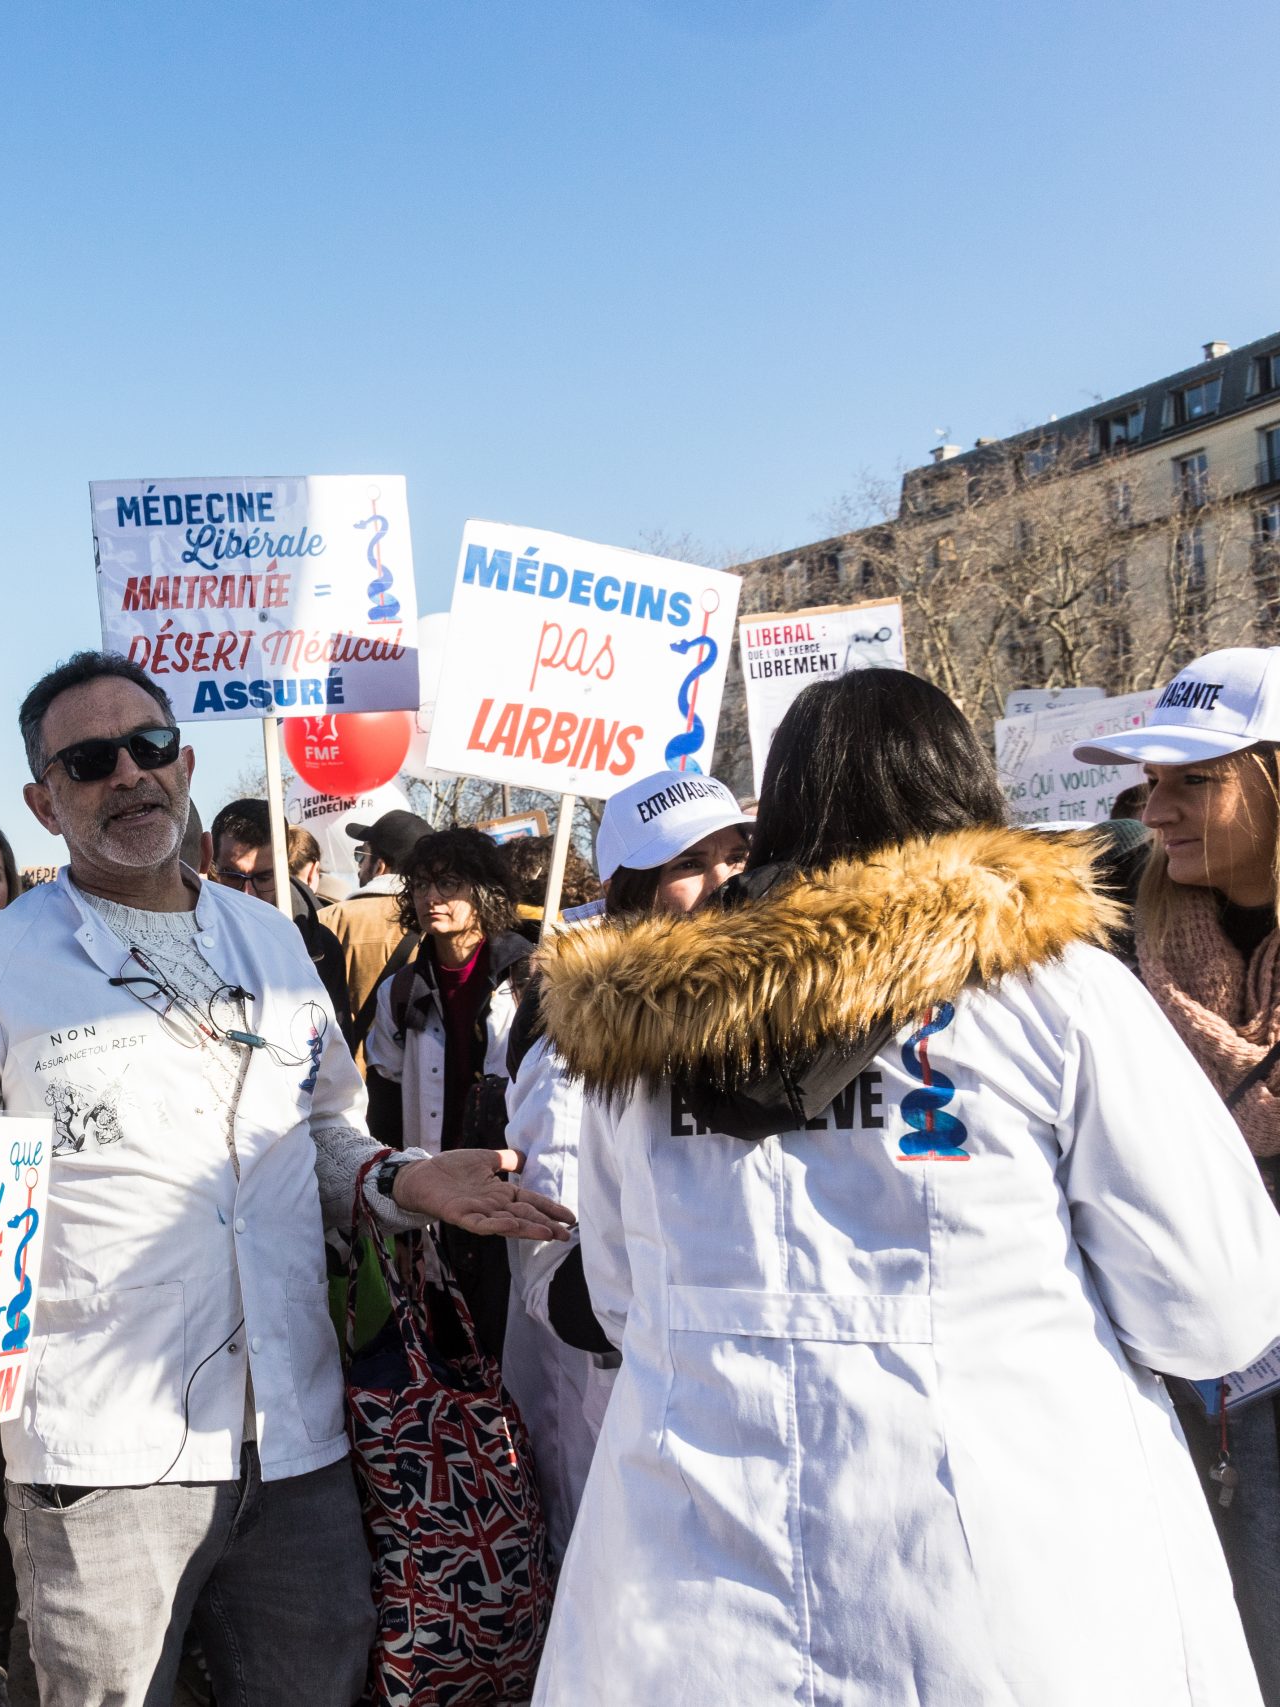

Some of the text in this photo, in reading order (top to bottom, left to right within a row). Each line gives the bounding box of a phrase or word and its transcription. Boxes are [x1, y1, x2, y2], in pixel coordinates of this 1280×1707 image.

[117, 485, 275, 527] MÉDECINE
[182, 524, 327, 570] Libérale
[121, 558, 291, 612] MALTRAITÉE
[462, 543, 692, 627] MÉDECINS
[128, 619, 406, 675] DÉSERT Médical
[529, 620, 615, 692] pas
[746, 623, 815, 648] LIBERAL
[789, 643, 820, 656] EXERCE
[750, 653, 838, 680] LIBREMENT
[193, 668, 345, 713] ASSURÉ
[305, 746, 340, 761] FMF
[466, 698, 644, 776] LARBINS
[1060, 765, 1121, 792] VOUDRA
[50, 1026, 97, 1046] NON
[9, 1139, 43, 1181] que
